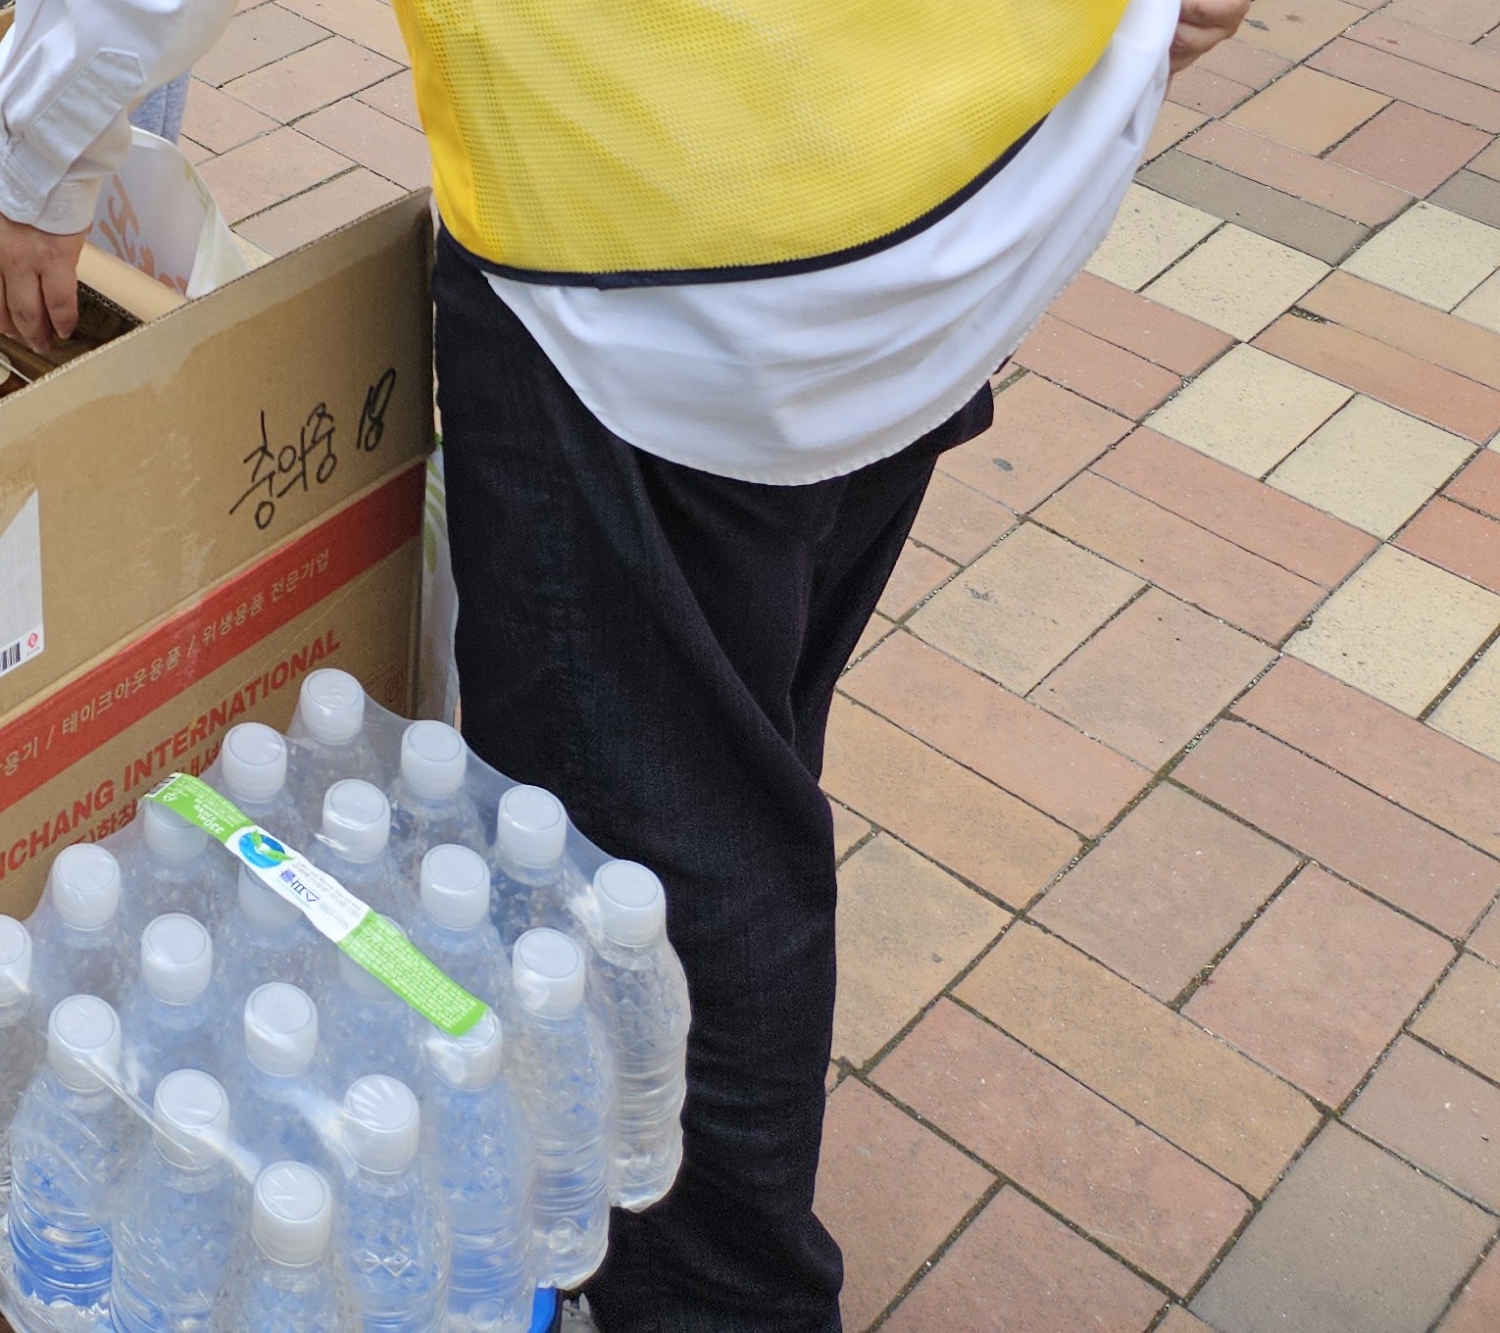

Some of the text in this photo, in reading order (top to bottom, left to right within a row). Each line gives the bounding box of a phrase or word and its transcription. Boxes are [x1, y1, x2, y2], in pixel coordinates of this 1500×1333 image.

[229, 368, 396, 530] 충의중 18
[61, 646, 182, 737] 테이크아웃용품
[202, 591, 264, 646] 위생용품
[270, 548, 330, 603] 전문기업
[124, 629, 341, 793] INTERNATIONAL
[280, 868, 321, 903] 스파클
